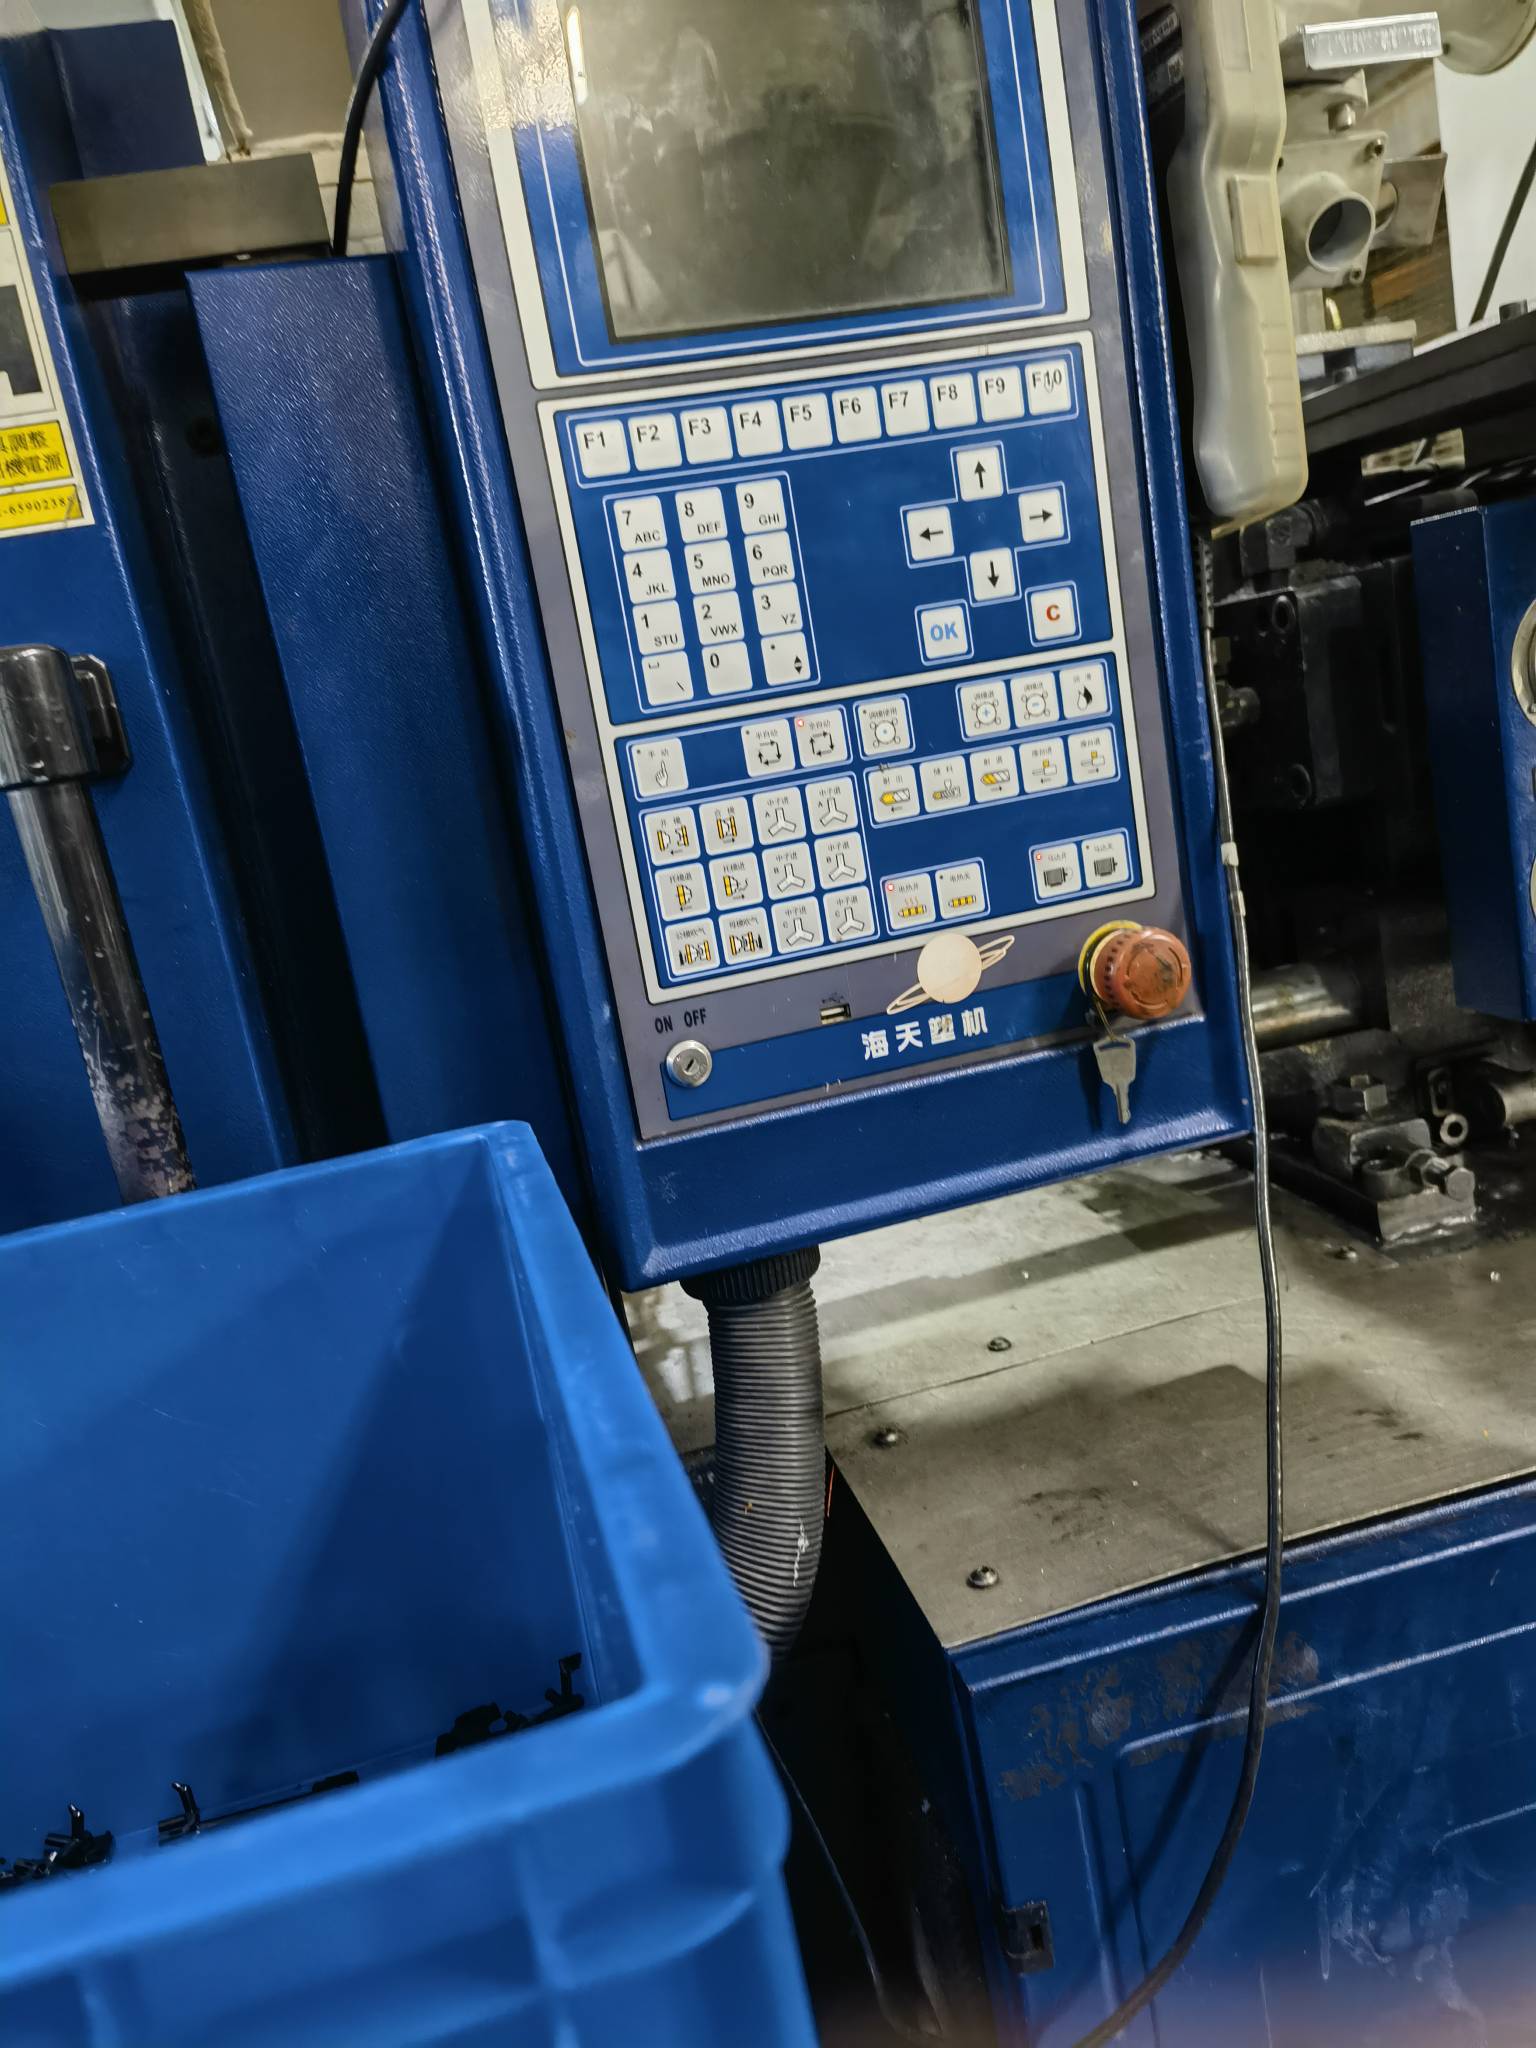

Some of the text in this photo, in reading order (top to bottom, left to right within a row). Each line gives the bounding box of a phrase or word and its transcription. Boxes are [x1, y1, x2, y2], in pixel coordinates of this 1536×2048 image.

[984, 377, 1006, 395] F9
[1032, 369, 1062, 388] F10
[888, 391, 909, 409] F7
[937, 384, 958, 402] F8
[789, 405, 813, 423] F5
[839, 398, 862, 417] F6
[688, 418, 712, 436] F3
[739, 411, 762, 430] F4
[583, 432, 606, 450] F1
[636, 424, 661, 443] F2
[744, 493, 755, 509] 9
[684, 502, 695, 517] 8
[622, 511, 632, 526] 7
[758, 513, 781, 526] GHI
[697, 521, 722, 535] DEF
[634, 531, 661, 545] ABC
[752, 545, 763, 561] 6
[632, 562, 643, 578] 4
[693, 554, 705, 570] 5
[762, 564, 789, 578] PQR
[646, 582, 669, 596] JKL
[702, 574, 730, 588] MNO
[761, 595, 772, 611] 3
[701, 604, 713, 620] 2
[781, 612, 798, 625] YZ
[1046, 604, 1061, 621] C
[641, 614, 650, 629] 1
[710, 624, 739, 637] VWX
[930, 621, 959, 642] OK
[654, 634, 679, 648] STU
[709, 653, 721, 669] 0
[655, 1008, 707, 1034] ON OFF
[861, 1006, 989, 1061] 海天塑机
